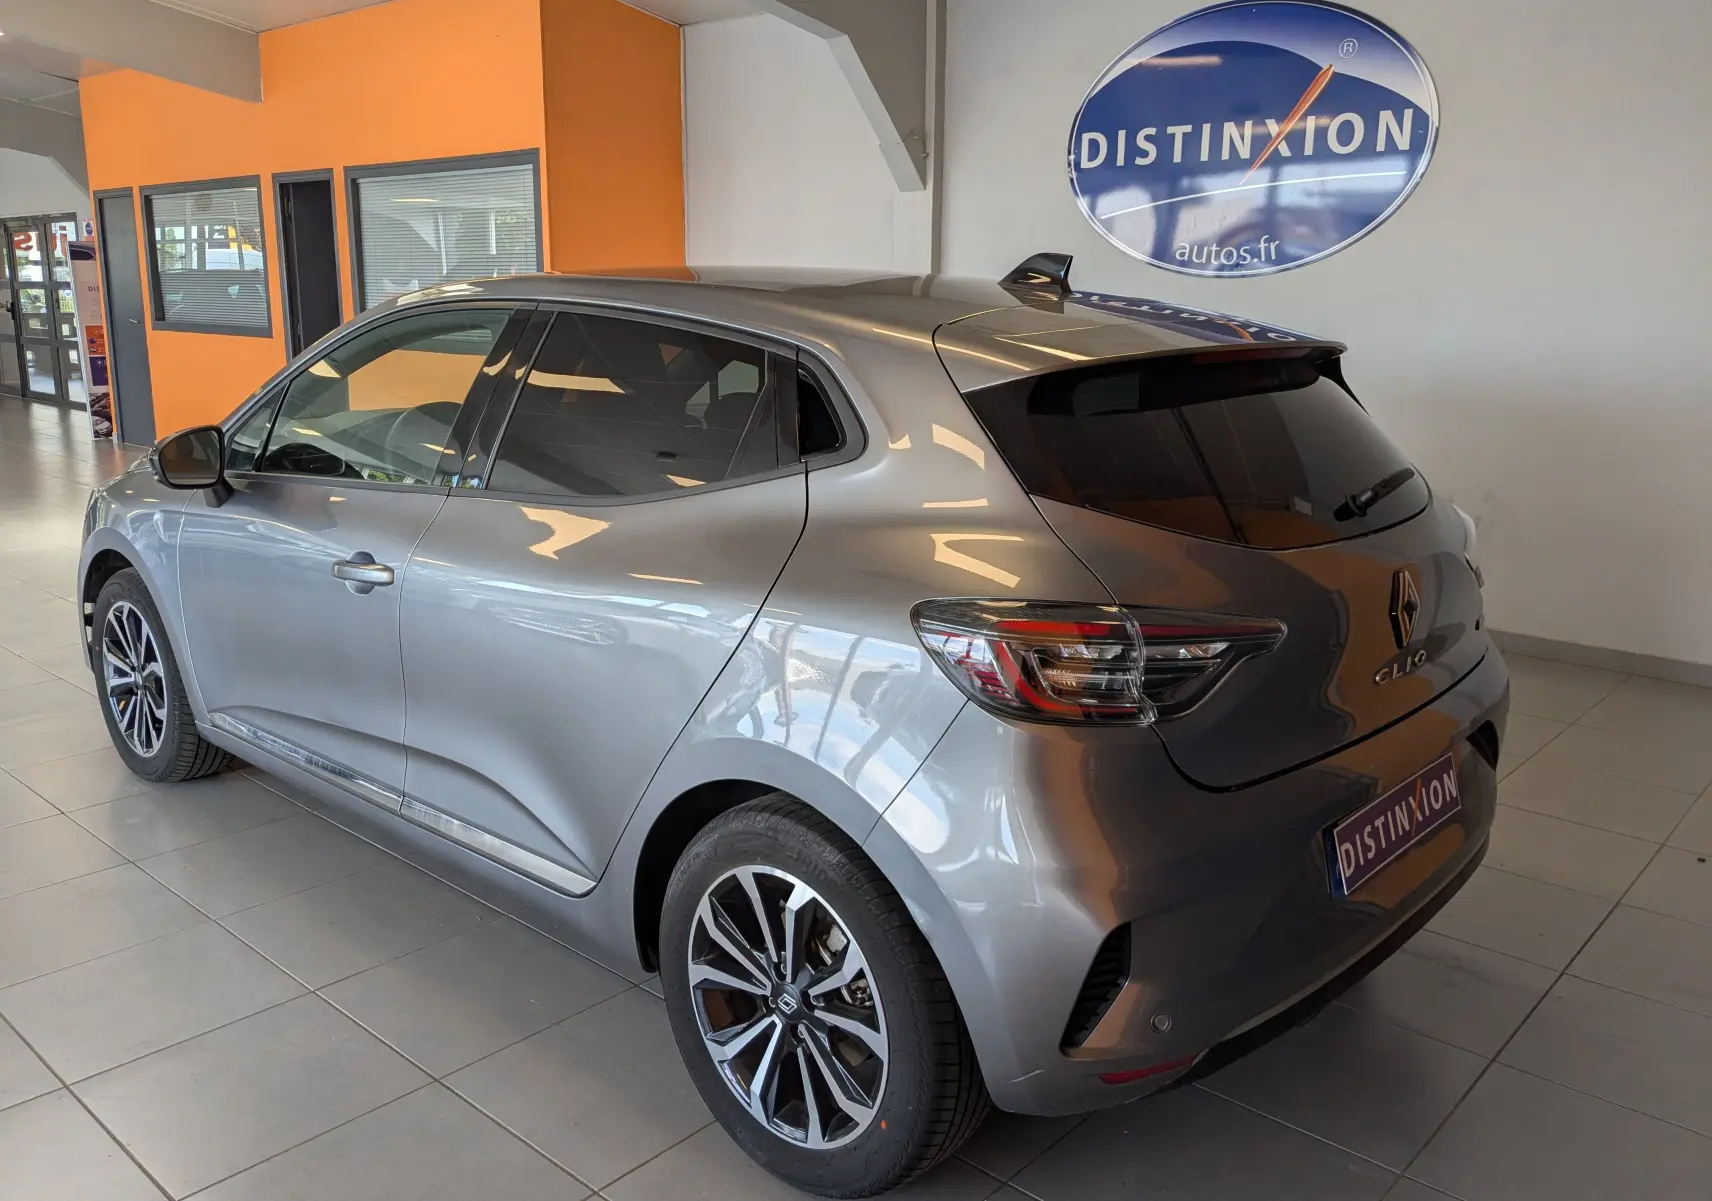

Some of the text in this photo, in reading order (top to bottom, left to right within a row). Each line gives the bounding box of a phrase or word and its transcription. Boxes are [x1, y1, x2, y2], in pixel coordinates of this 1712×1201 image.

[1079, 107, 1414, 170] DISTINXION
[1174, 234, 1281, 266] autos.fr
[1374, 648, 1428, 686] CLIO
[1340, 769, 1457, 878] DISTINXION
